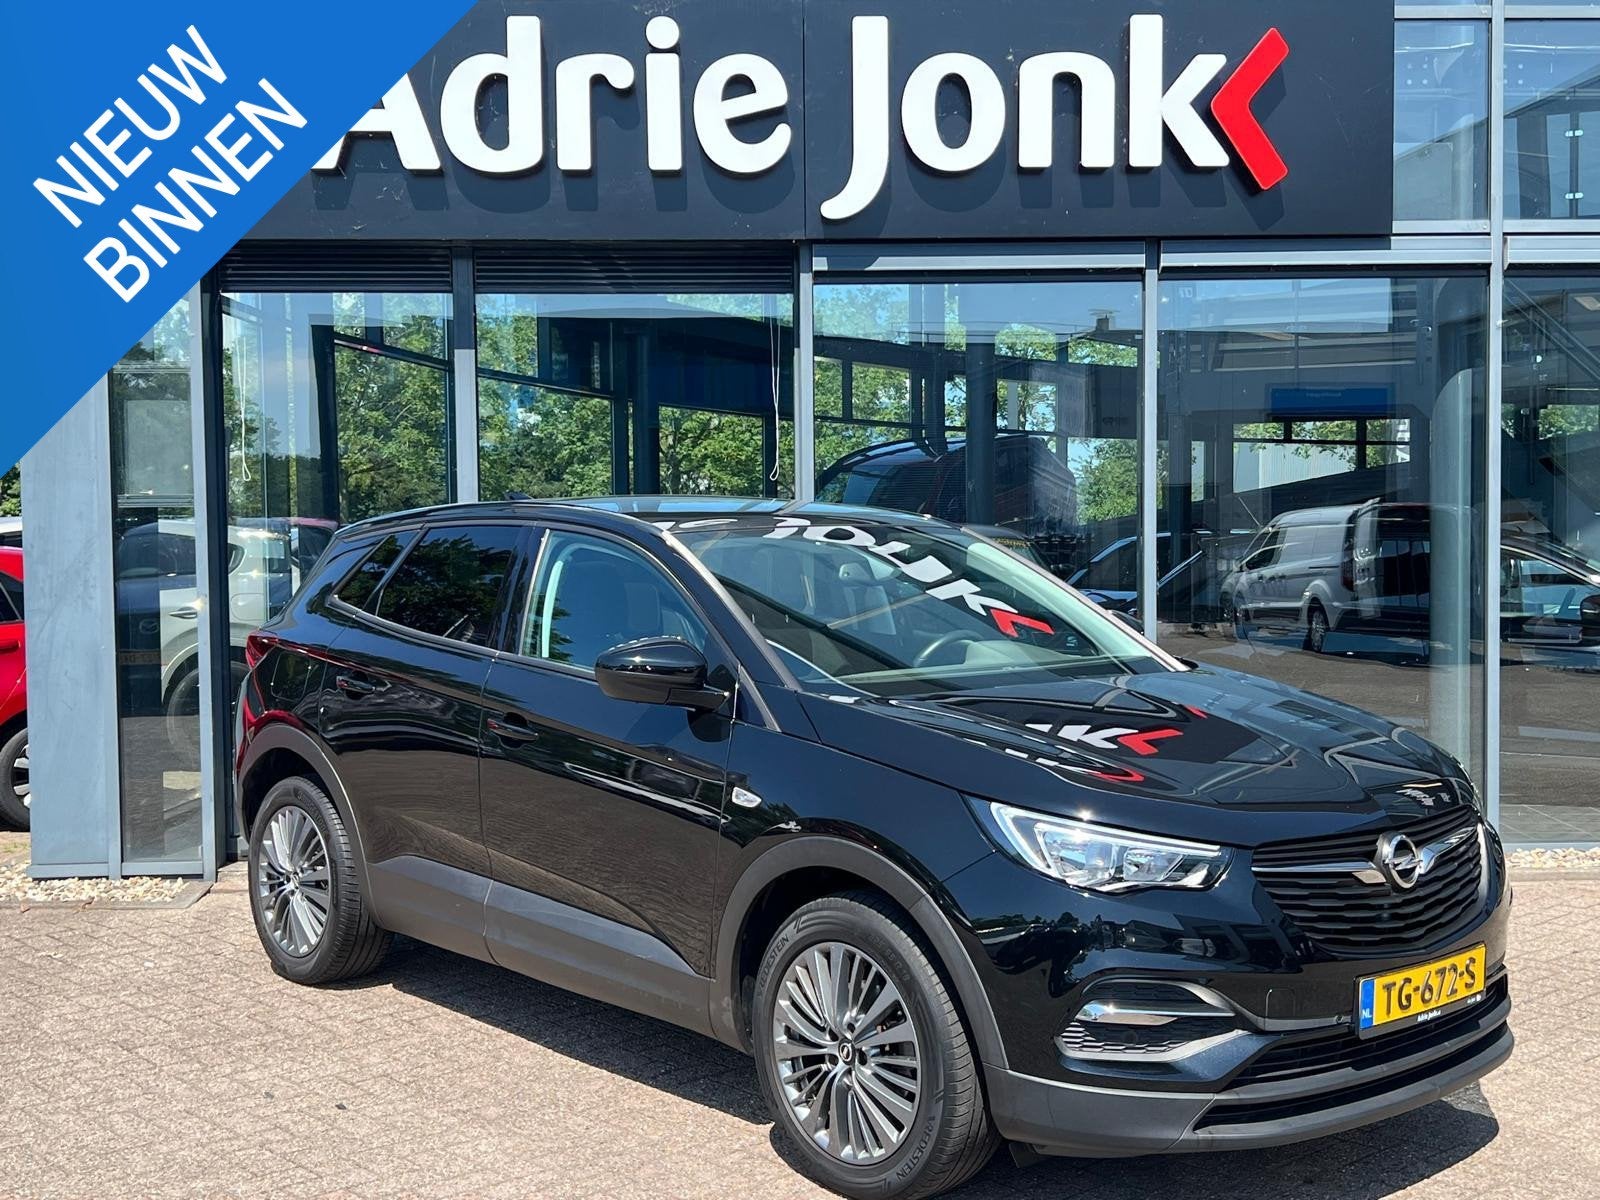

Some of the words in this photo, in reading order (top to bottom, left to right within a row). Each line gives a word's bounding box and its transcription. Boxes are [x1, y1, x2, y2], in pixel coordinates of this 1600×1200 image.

[311, 16, 792, 174] Adrie
[821, 15, 1229, 219] Jonk
[1362, 1008, 1372, 1019] NL
[1382, 956, 1476, 1018] TG-672-S
